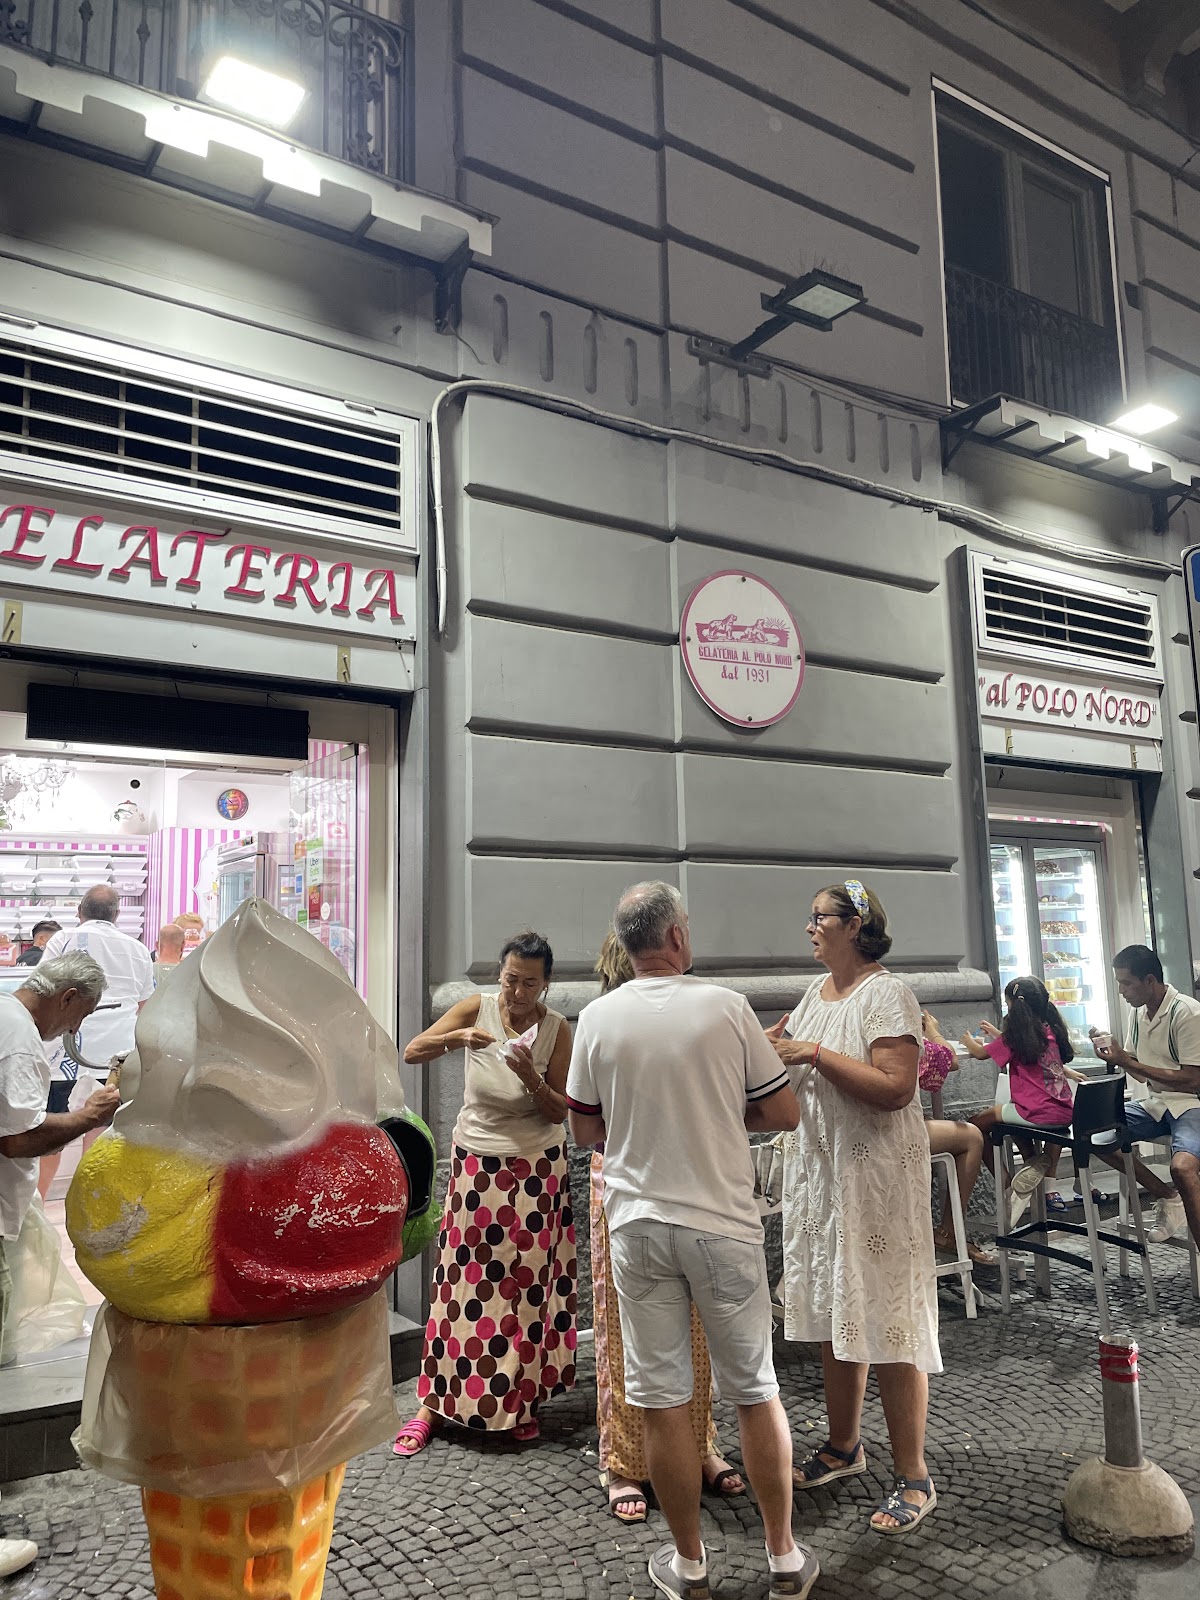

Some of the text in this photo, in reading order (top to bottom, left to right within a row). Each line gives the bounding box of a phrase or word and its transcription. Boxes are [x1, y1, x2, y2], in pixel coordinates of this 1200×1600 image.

[0, 504, 404, 620] ELATERIA
[699, 646, 792, 666] GELATERIA AL POLO NORD
[721, 665, 770, 683] dal 1931
[1015, 682, 1077, 716] POLO
